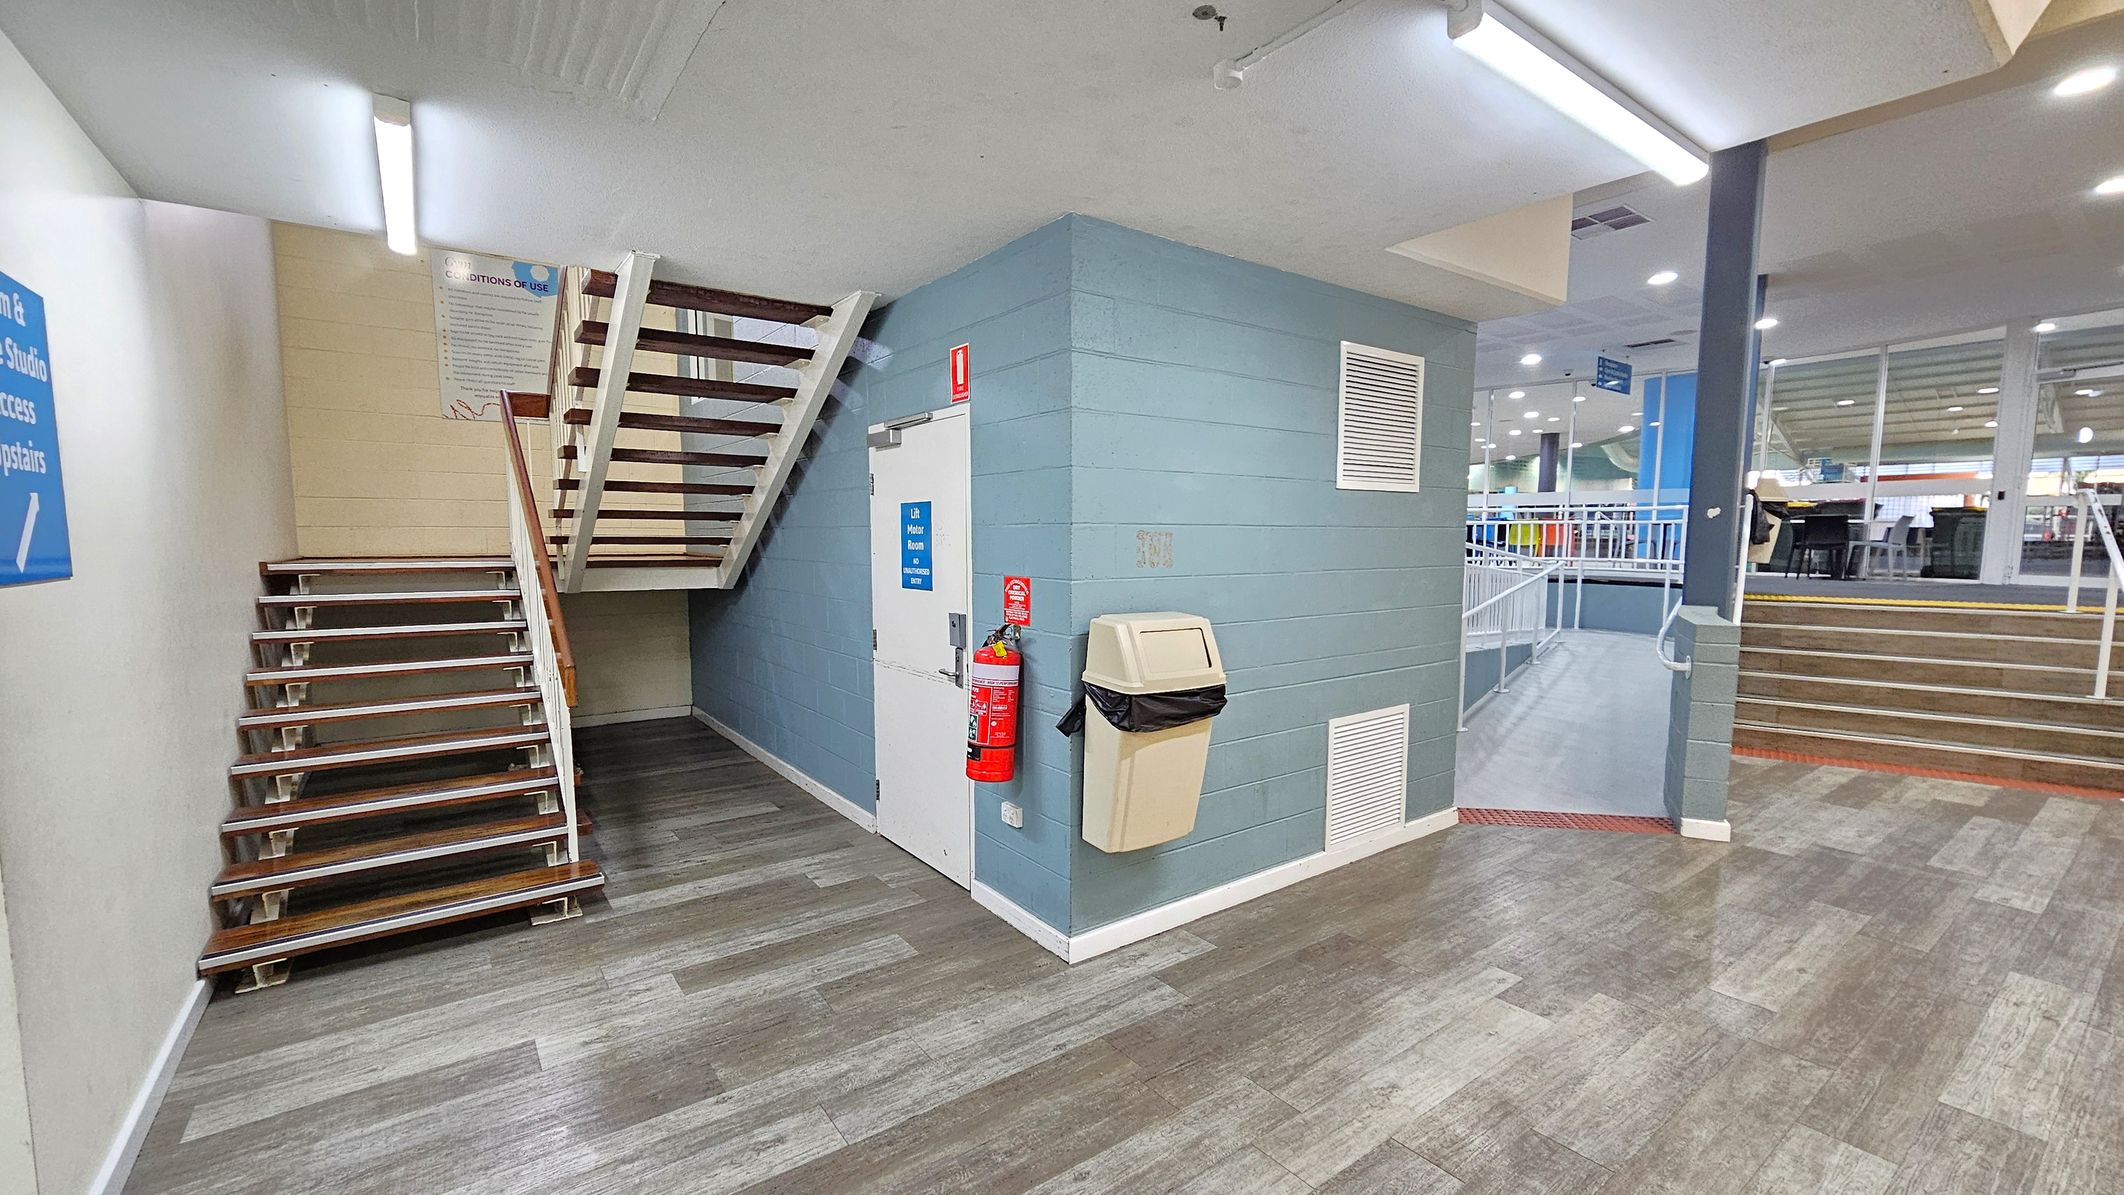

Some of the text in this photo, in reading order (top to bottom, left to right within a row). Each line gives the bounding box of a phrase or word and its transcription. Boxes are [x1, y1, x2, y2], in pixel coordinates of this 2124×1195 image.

[445, 270, 549, 292] CONDITIONS OF USE
[13, 292, 26, 327] &
[5, 336, 48, 382] Studio
[0, 391, 37, 424] ccess
[0, 440, 47, 477] pstairs
[910, 507, 920, 519] Lift
[907, 523, 924, 535] Motor
[907, 539, 924, 550] Room
[912, 557, 920, 565] NO
[910, 577, 923, 585] ENTRY
